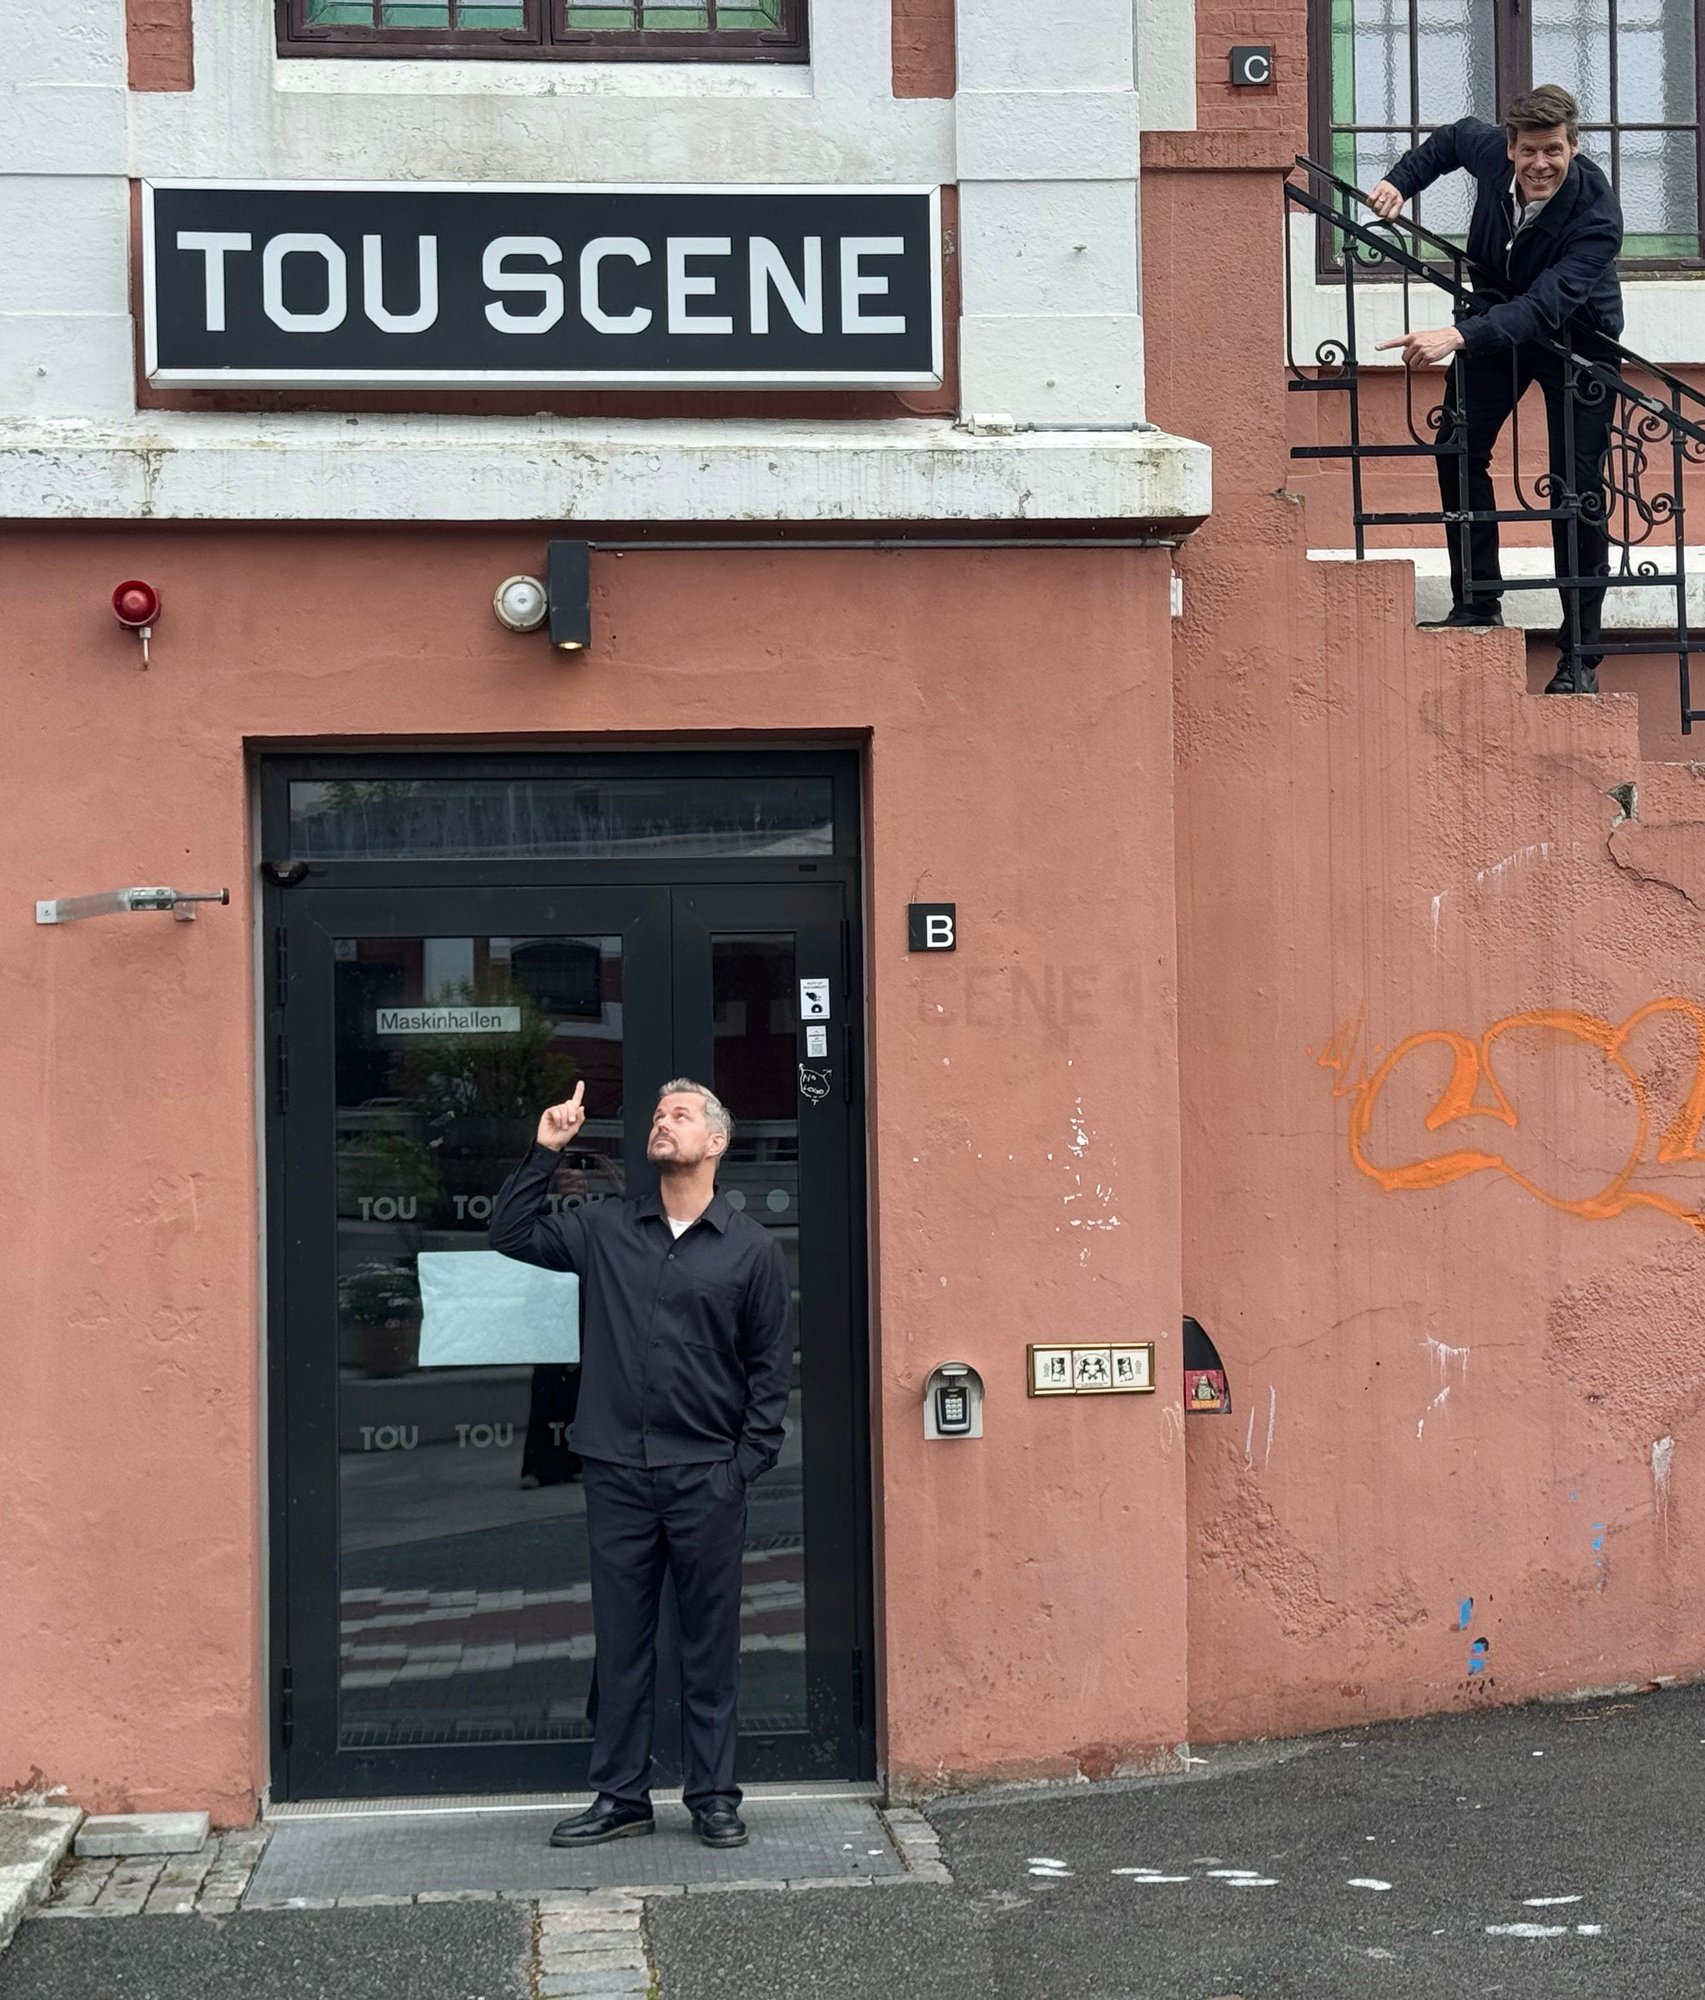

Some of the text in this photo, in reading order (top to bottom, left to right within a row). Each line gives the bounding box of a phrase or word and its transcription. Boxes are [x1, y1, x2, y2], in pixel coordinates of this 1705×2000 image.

[1244, 55, 1269, 82] C
[176, 232, 907, 335] TOU SCENE
[926, 915, 954, 948] B
[380, 1011, 502, 1030] Maskinhallen
[358, 1195, 417, 1222] TOU
[359, 1423, 514, 1451] TOU TOU
